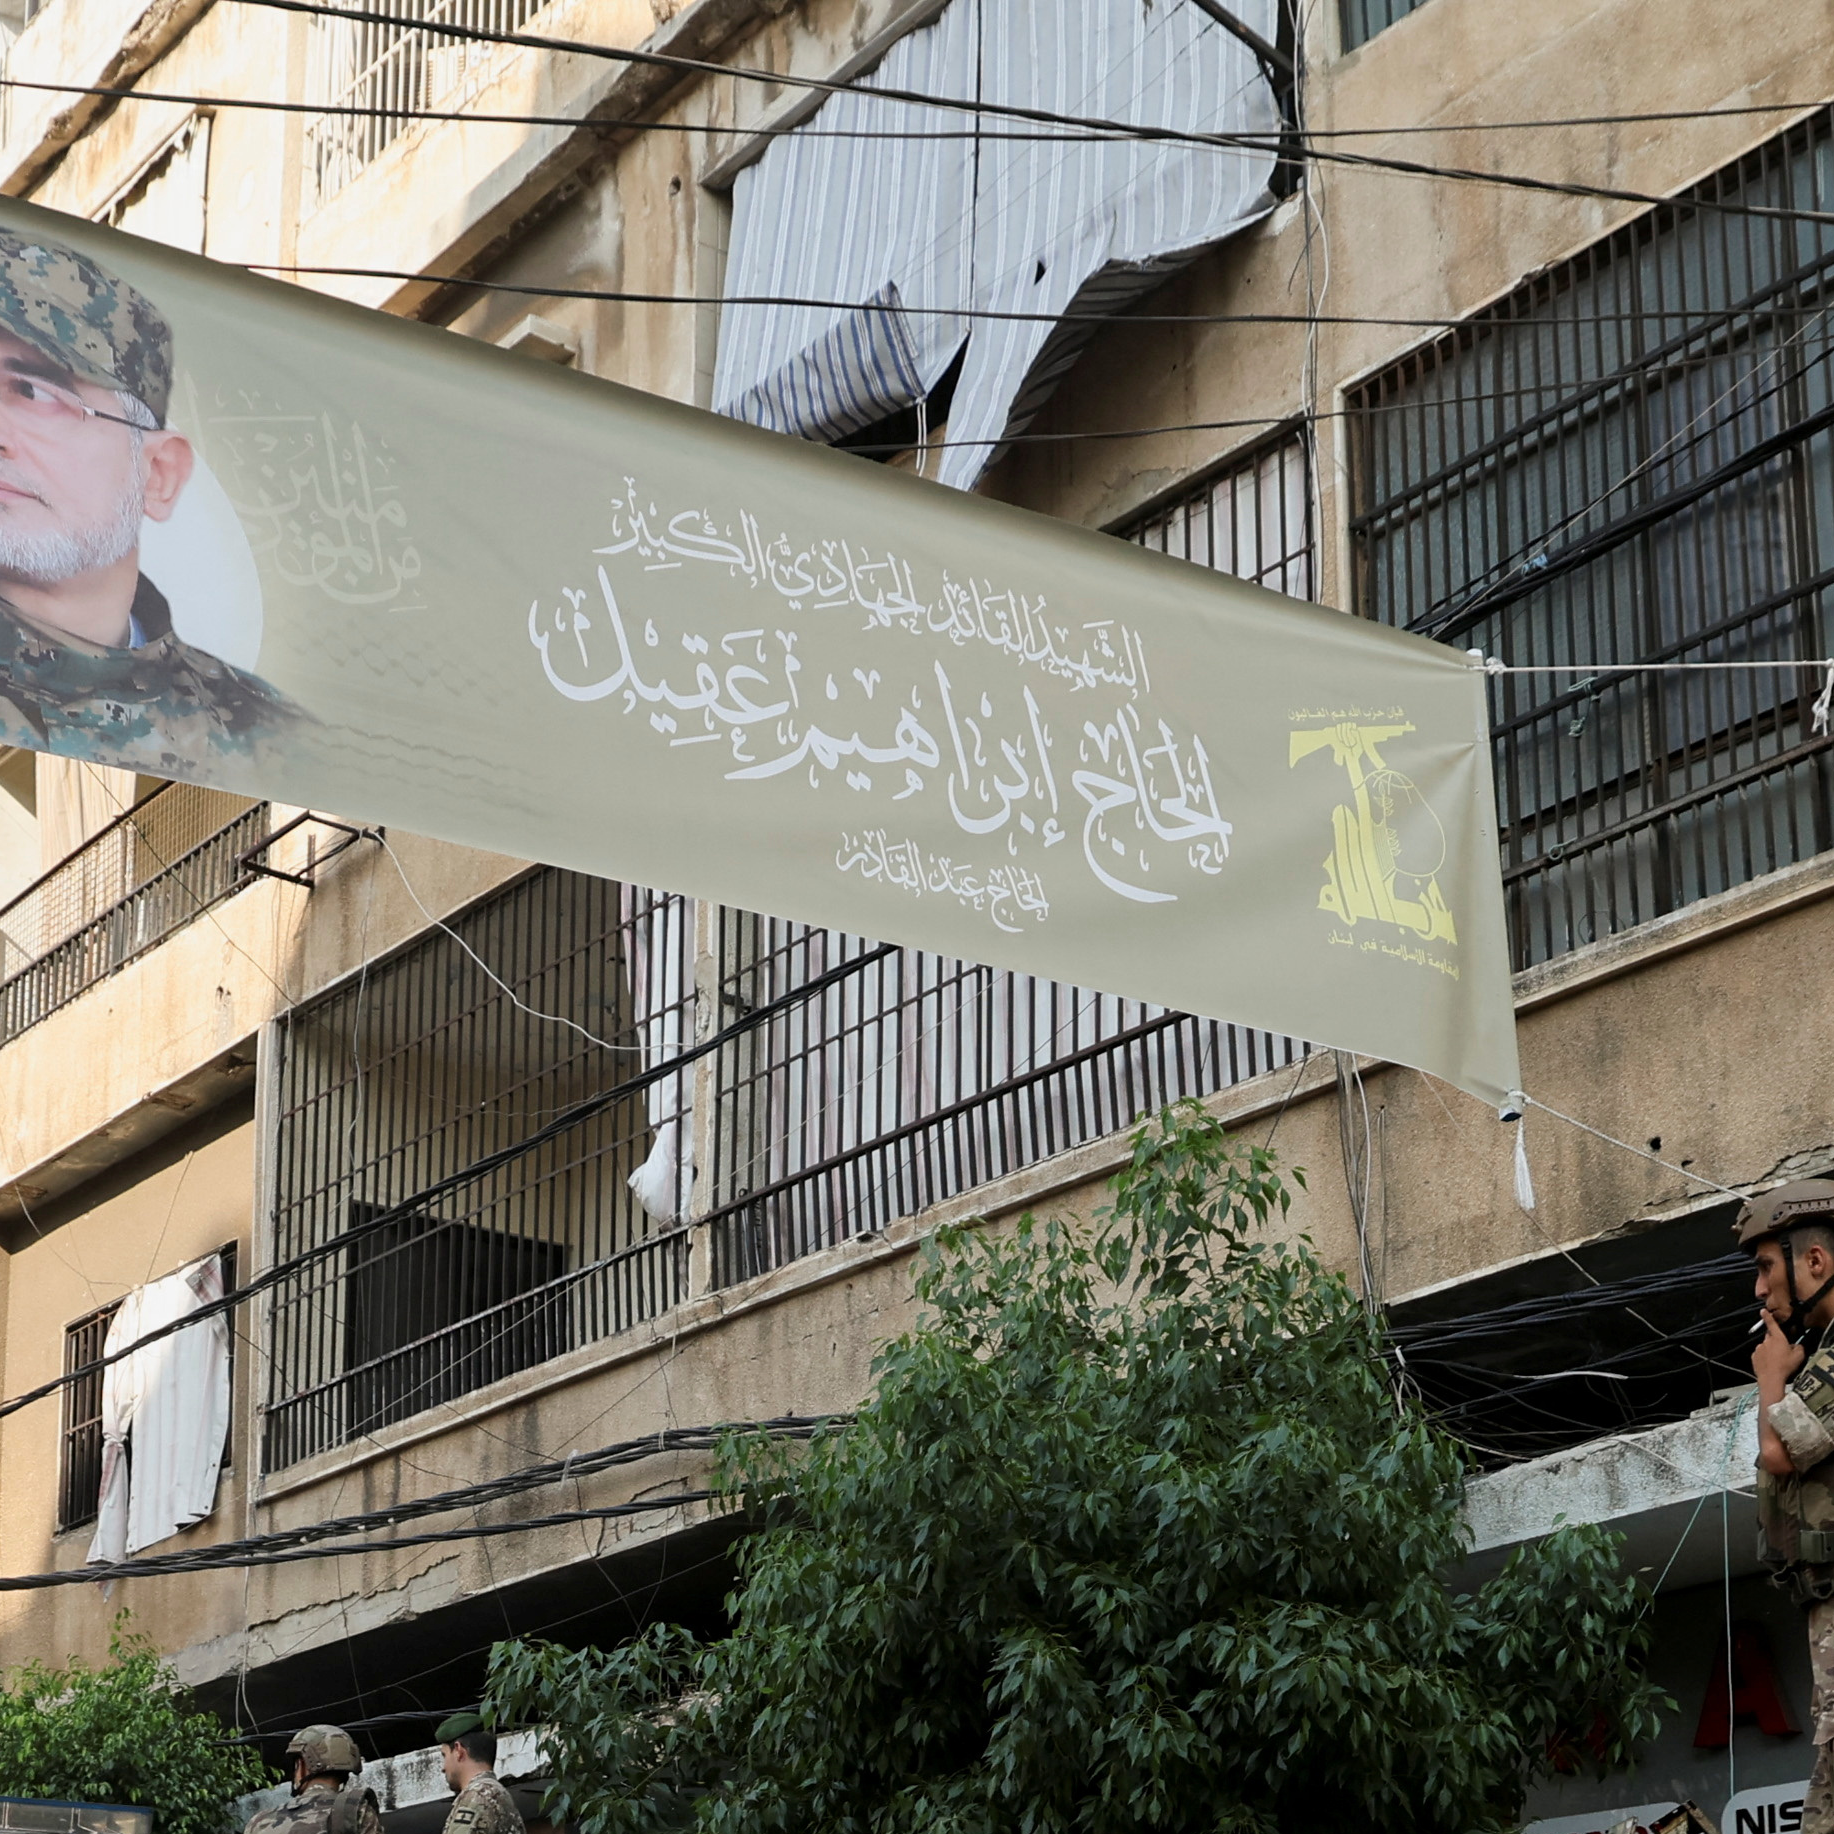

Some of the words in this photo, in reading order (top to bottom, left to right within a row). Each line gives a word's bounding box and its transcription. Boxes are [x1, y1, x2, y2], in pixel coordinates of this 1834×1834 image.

[592, 476, 767, 588] الكبير
[528, 566, 807, 763] عقيل
[1072, 705, 1233, 903] الحاج
[835, 828, 928, 897] القادر
[928, 853, 985, 910] عبد
[987, 864, 1049, 933] الحاج
